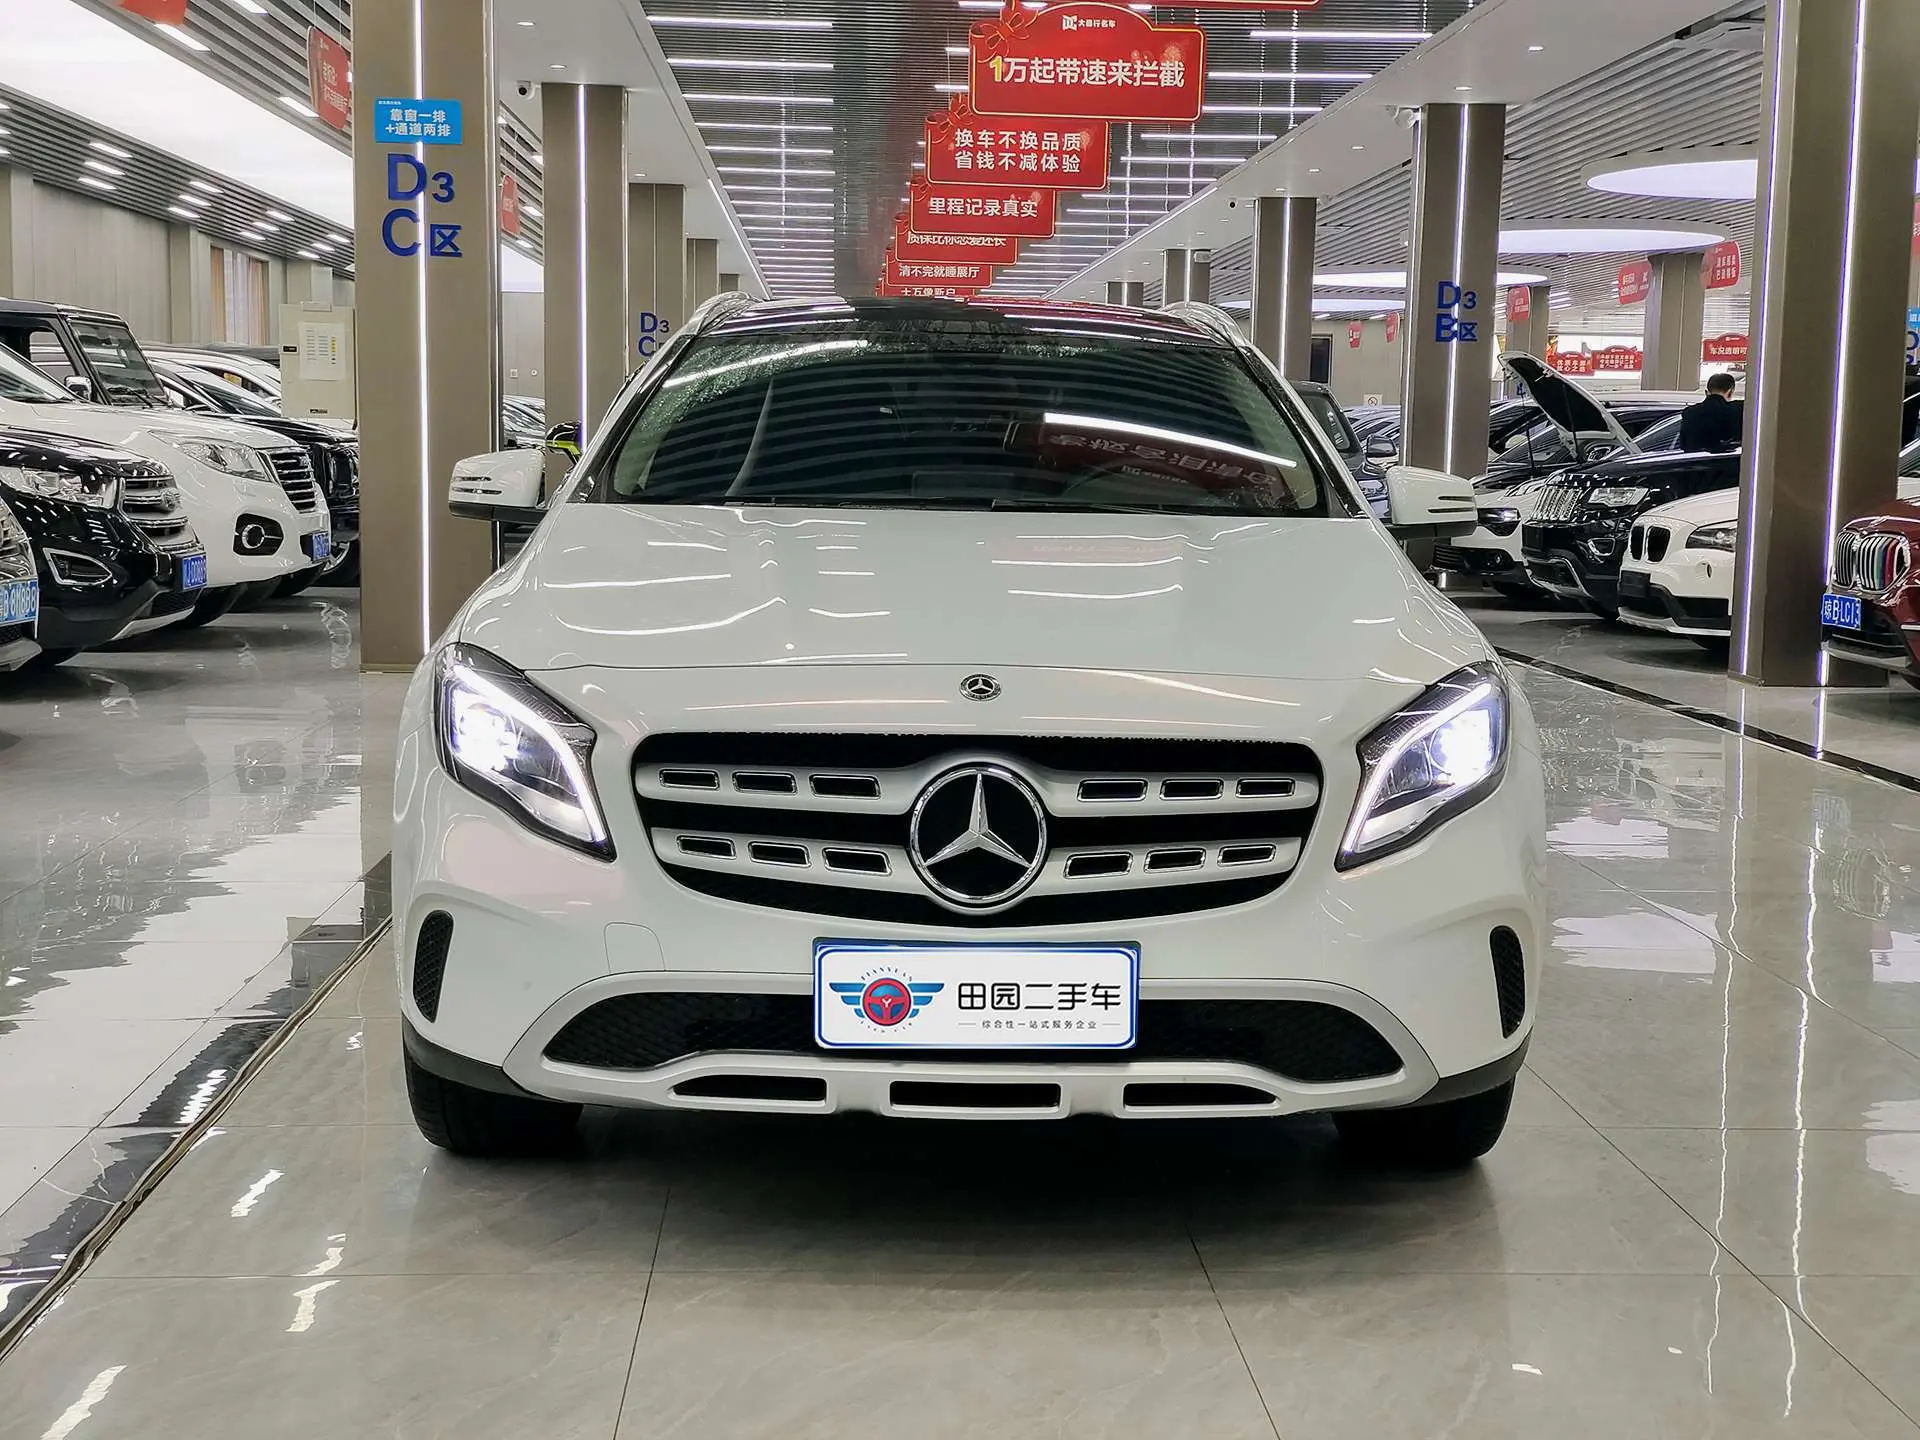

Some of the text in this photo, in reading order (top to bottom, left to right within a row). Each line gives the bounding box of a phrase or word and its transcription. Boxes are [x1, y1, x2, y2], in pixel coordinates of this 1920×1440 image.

[989, 56, 1186, 88] 1万起带速来拦截
[390, 108, 446, 123] 靠窗一排
[955, 128, 1081, 152] 换车不换品质
[955, 150, 1080, 173] 省钱不减体验
[929, 197, 1038, 218] 里程记录真实
[899, 265, 980, 279] 清不完就睡展厅
[958, 983, 1121, 1010] 田园二手车
[982, 1020, 1097, 1030] 综合性一站式服务企业
